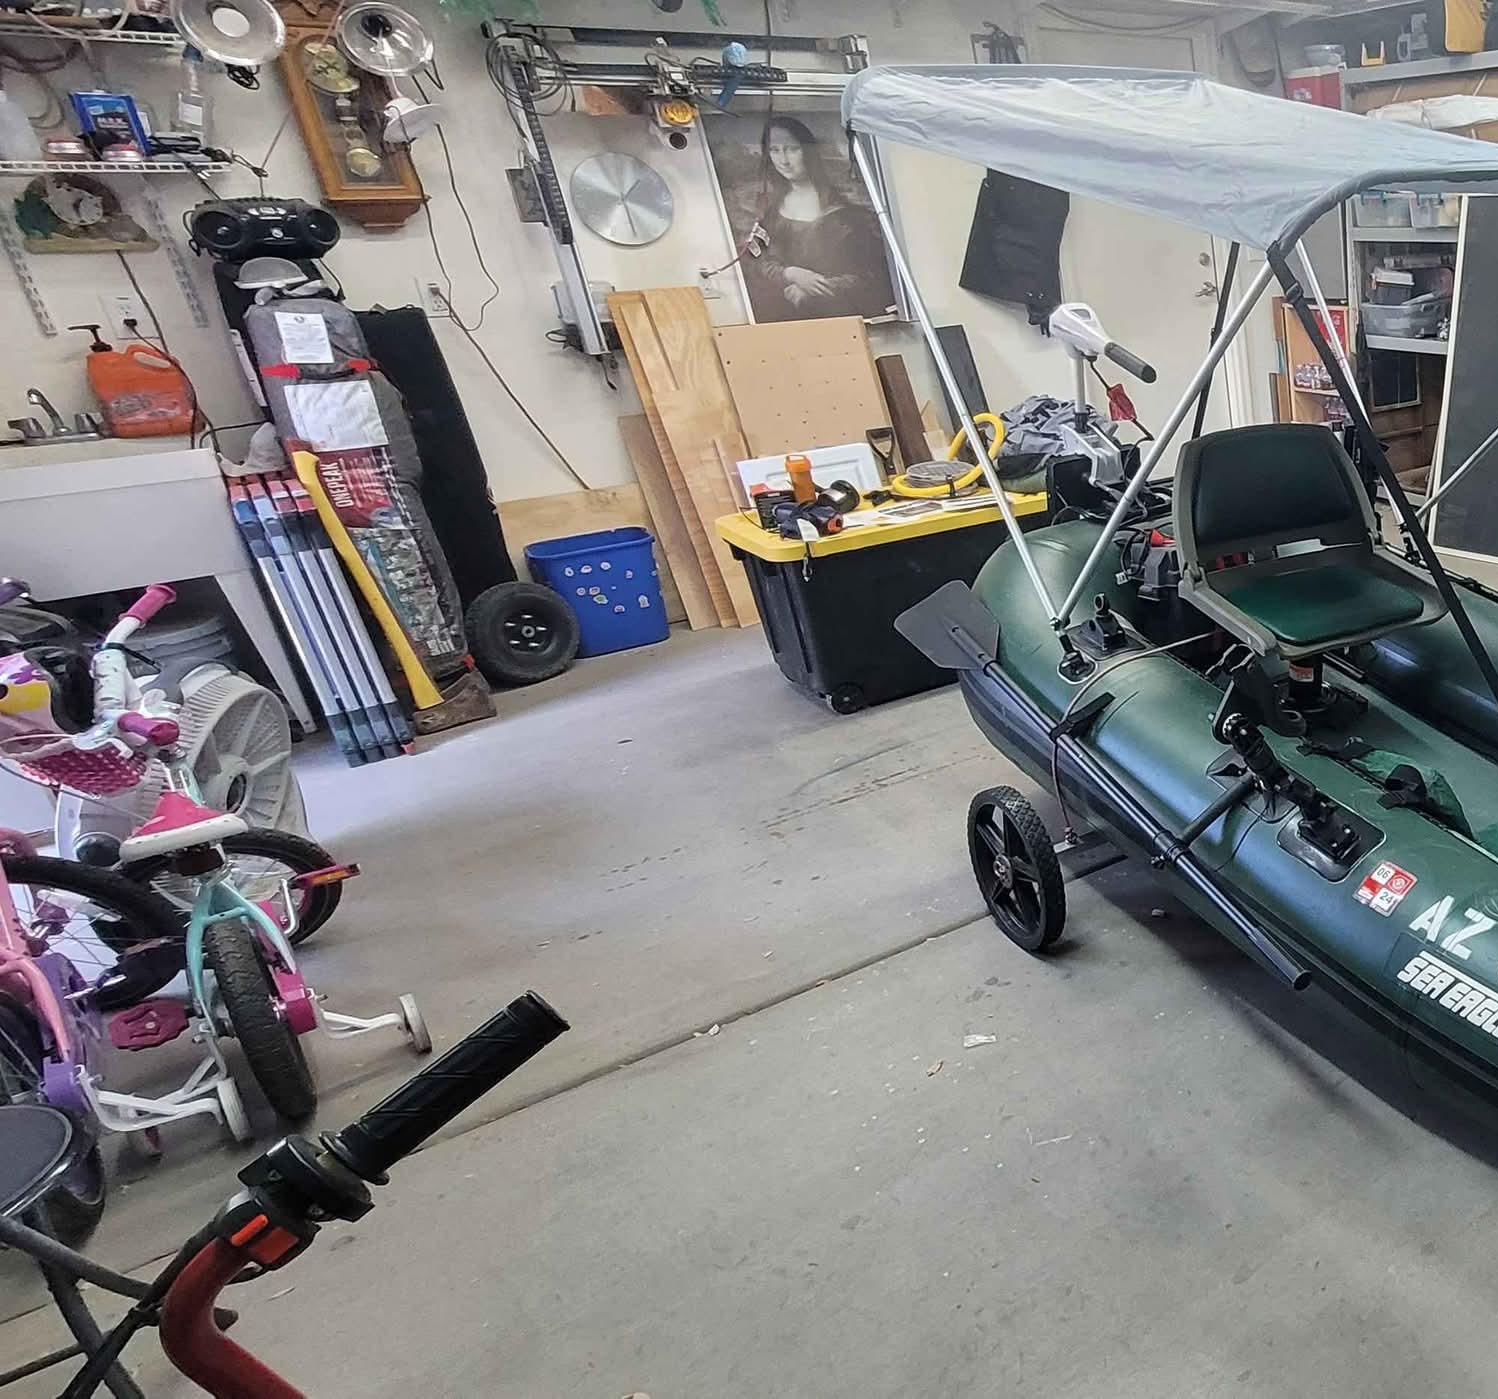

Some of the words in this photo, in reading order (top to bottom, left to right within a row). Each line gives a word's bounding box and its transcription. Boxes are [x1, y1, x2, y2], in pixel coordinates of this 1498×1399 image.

[323, 461, 355, 508] ONEPEAK
[1376, 867, 1391, 879] 06
[1379, 891, 1395, 904] 24
[1408, 895, 1496, 961] AZ
[1396, 956, 1448, 1000] SEA
